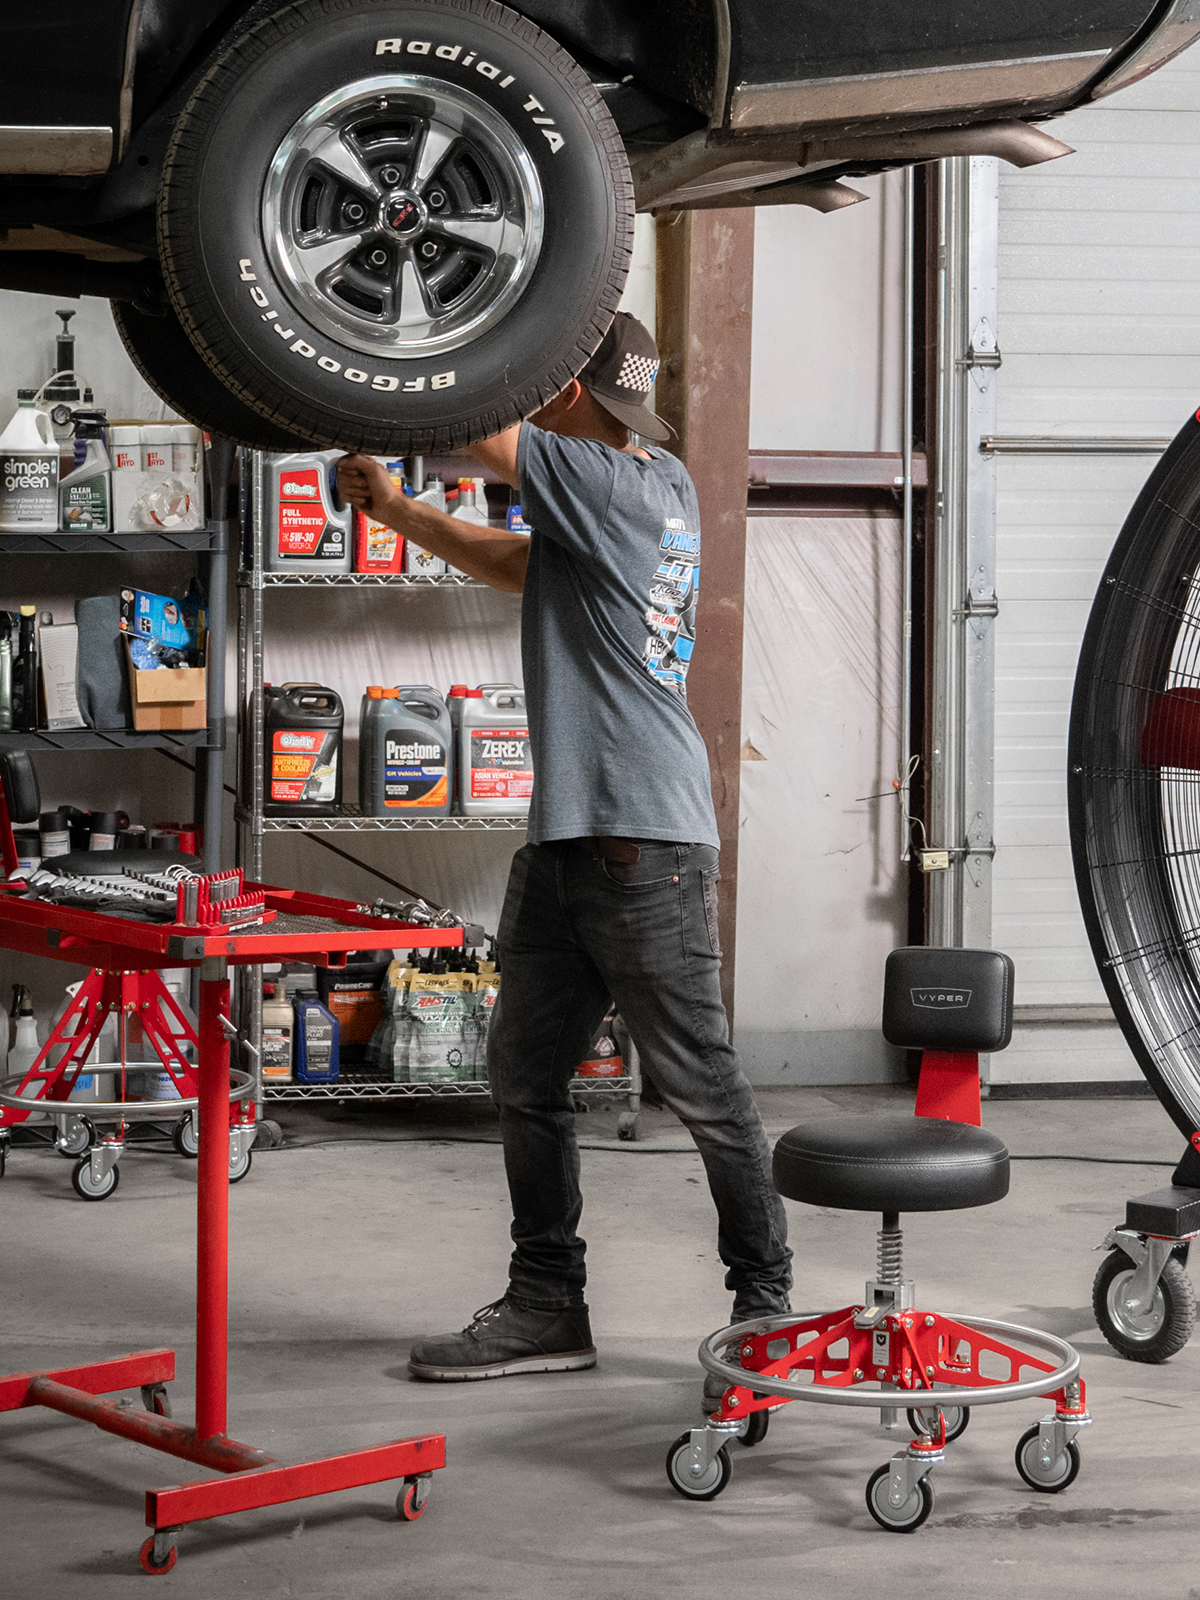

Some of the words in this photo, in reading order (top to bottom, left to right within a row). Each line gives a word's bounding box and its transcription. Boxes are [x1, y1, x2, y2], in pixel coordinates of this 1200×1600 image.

[375, 38, 516, 89] Radial
[523, 94, 565, 154] T/A
[238, 258, 456, 393] BFGoodrich
[4, 458, 50, 477] simple
[5, 476, 49, 492] green
[282, 517, 323, 525] SYNTHETIC
[290, 532, 314, 542] 5W-30
[386, 741, 441, 759] Prestone
[481, 740, 525, 758] ZEREX
[274, 758, 311, 766] ANTIFREEZE
[280, 765, 309, 773] COOLANT
[413, 996, 457, 1008] AMSOIL
[919, 994, 963, 1002] VYPER
